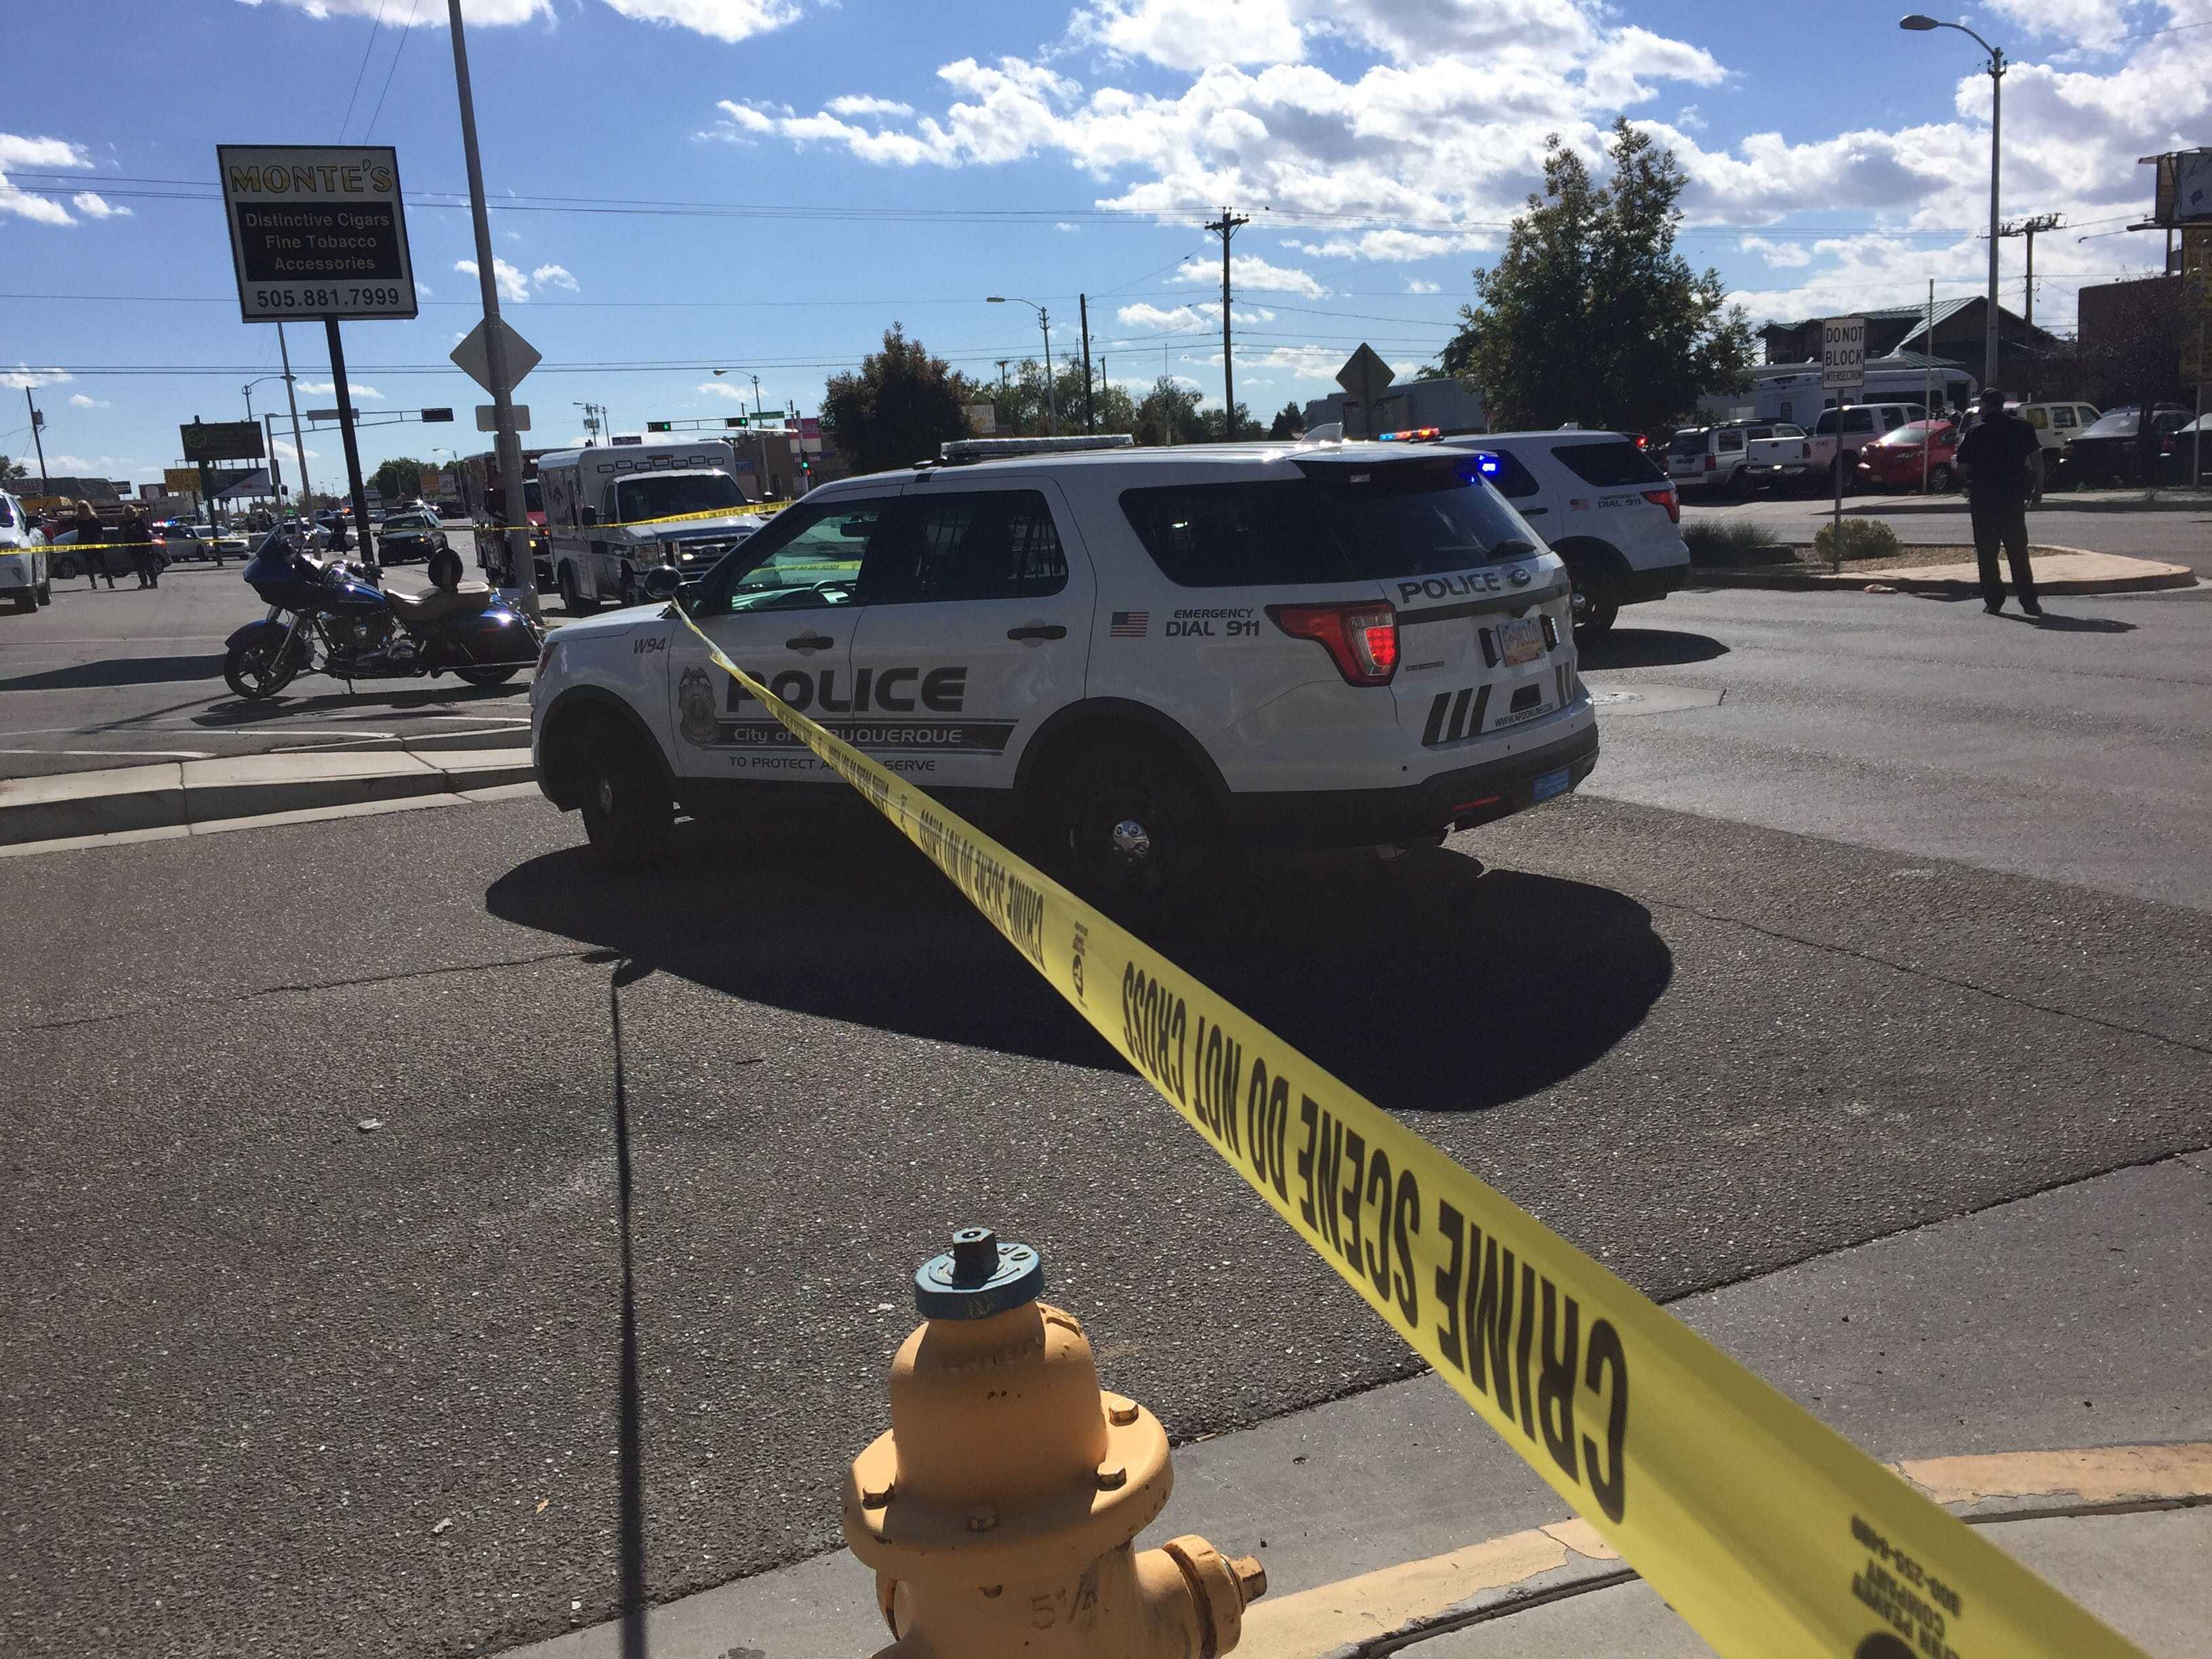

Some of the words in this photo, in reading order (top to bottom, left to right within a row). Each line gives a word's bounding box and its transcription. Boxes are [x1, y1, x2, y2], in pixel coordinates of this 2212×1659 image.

[229, 159, 392, 193] MONTE'S
[246, 213, 332, 228] Distinctive
[338, 213, 389, 230] Cigars
[266, 235, 302, 249] Fine
[306, 234, 377, 249] Tobacco
[274, 257, 375, 270] Accessories
[257, 287, 399, 308] 505.881.7999
[1826, 327, 1841, 343] DO
[1843, 326, 1864, 342] NOT
[1826, 349, 1863, 366] BLOCK
[1825, 369, 1863, 382] INTERSECTION
[1598, 499, 1622, 508] DIAL
[1625, 498, 1641, 506] 911
[1397, 573, 1502, 603] POLICE
[1173, 608, 1254, 619] EMERGENCY
[1166, 621, 1216, 637] DIAL
[1225, 620, 1261, 637] 911
[633, 637, 666, 655] W94
[725, 666, 968, 713] POLICE
[734, 728, 768, 744] City
[775, 730, 793, 741] of
[729, 756, 746, 768] TO
[752, 757, 815, 769] PROTECT
[884, 759, 935, 771] SERVE
[1122, 960, 1187, 1107] CROSS
[1193, 1015, 1242, 1159] NOT
[1247, 1057, 1290, 1206] DO
[1297, 1095, 1420, 1328] SCENE
[1435, 1198, 1627, 1525] CRIME
